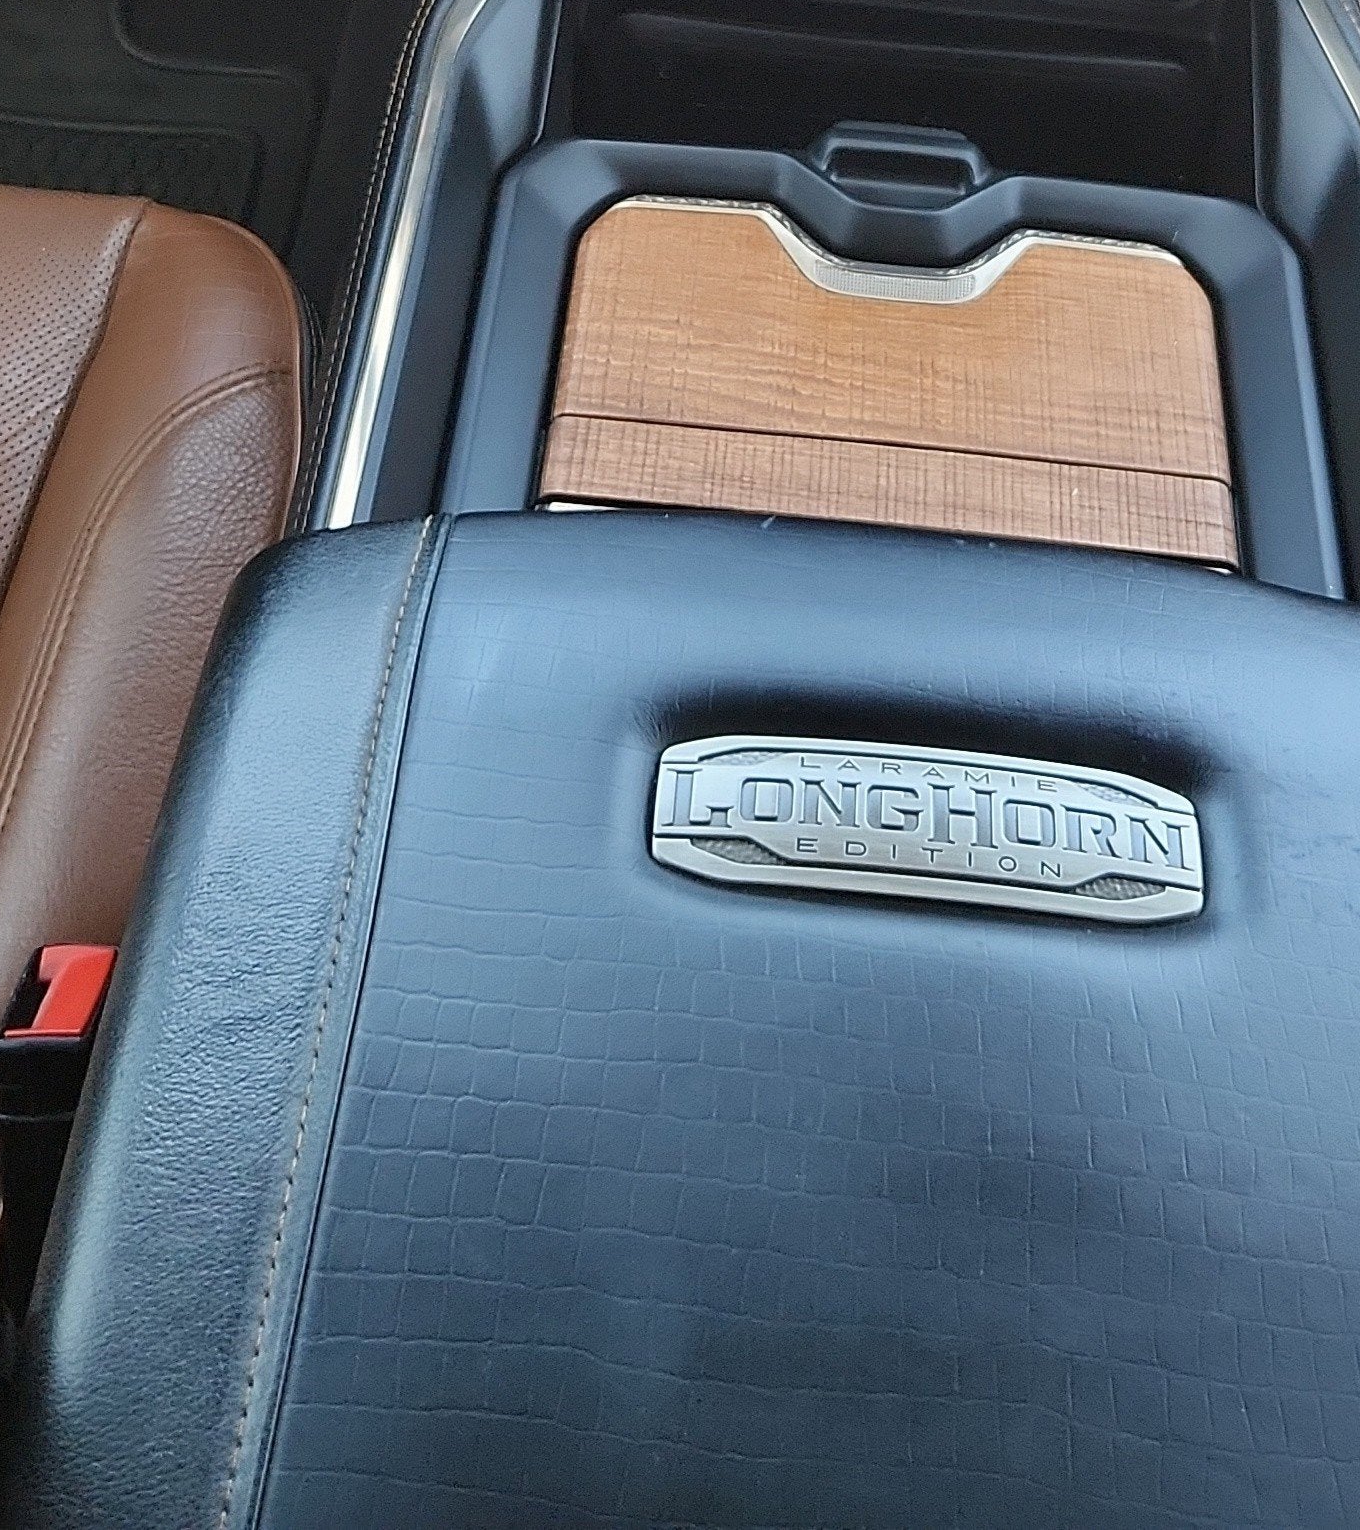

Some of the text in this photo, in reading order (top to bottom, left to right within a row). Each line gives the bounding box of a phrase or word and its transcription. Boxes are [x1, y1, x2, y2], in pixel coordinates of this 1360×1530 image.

[798, 754, 1059, 792] LARAMIE
[660, 767, 1200, 873] LONGHORN
[795, 836, 1063, 879] EDITION
